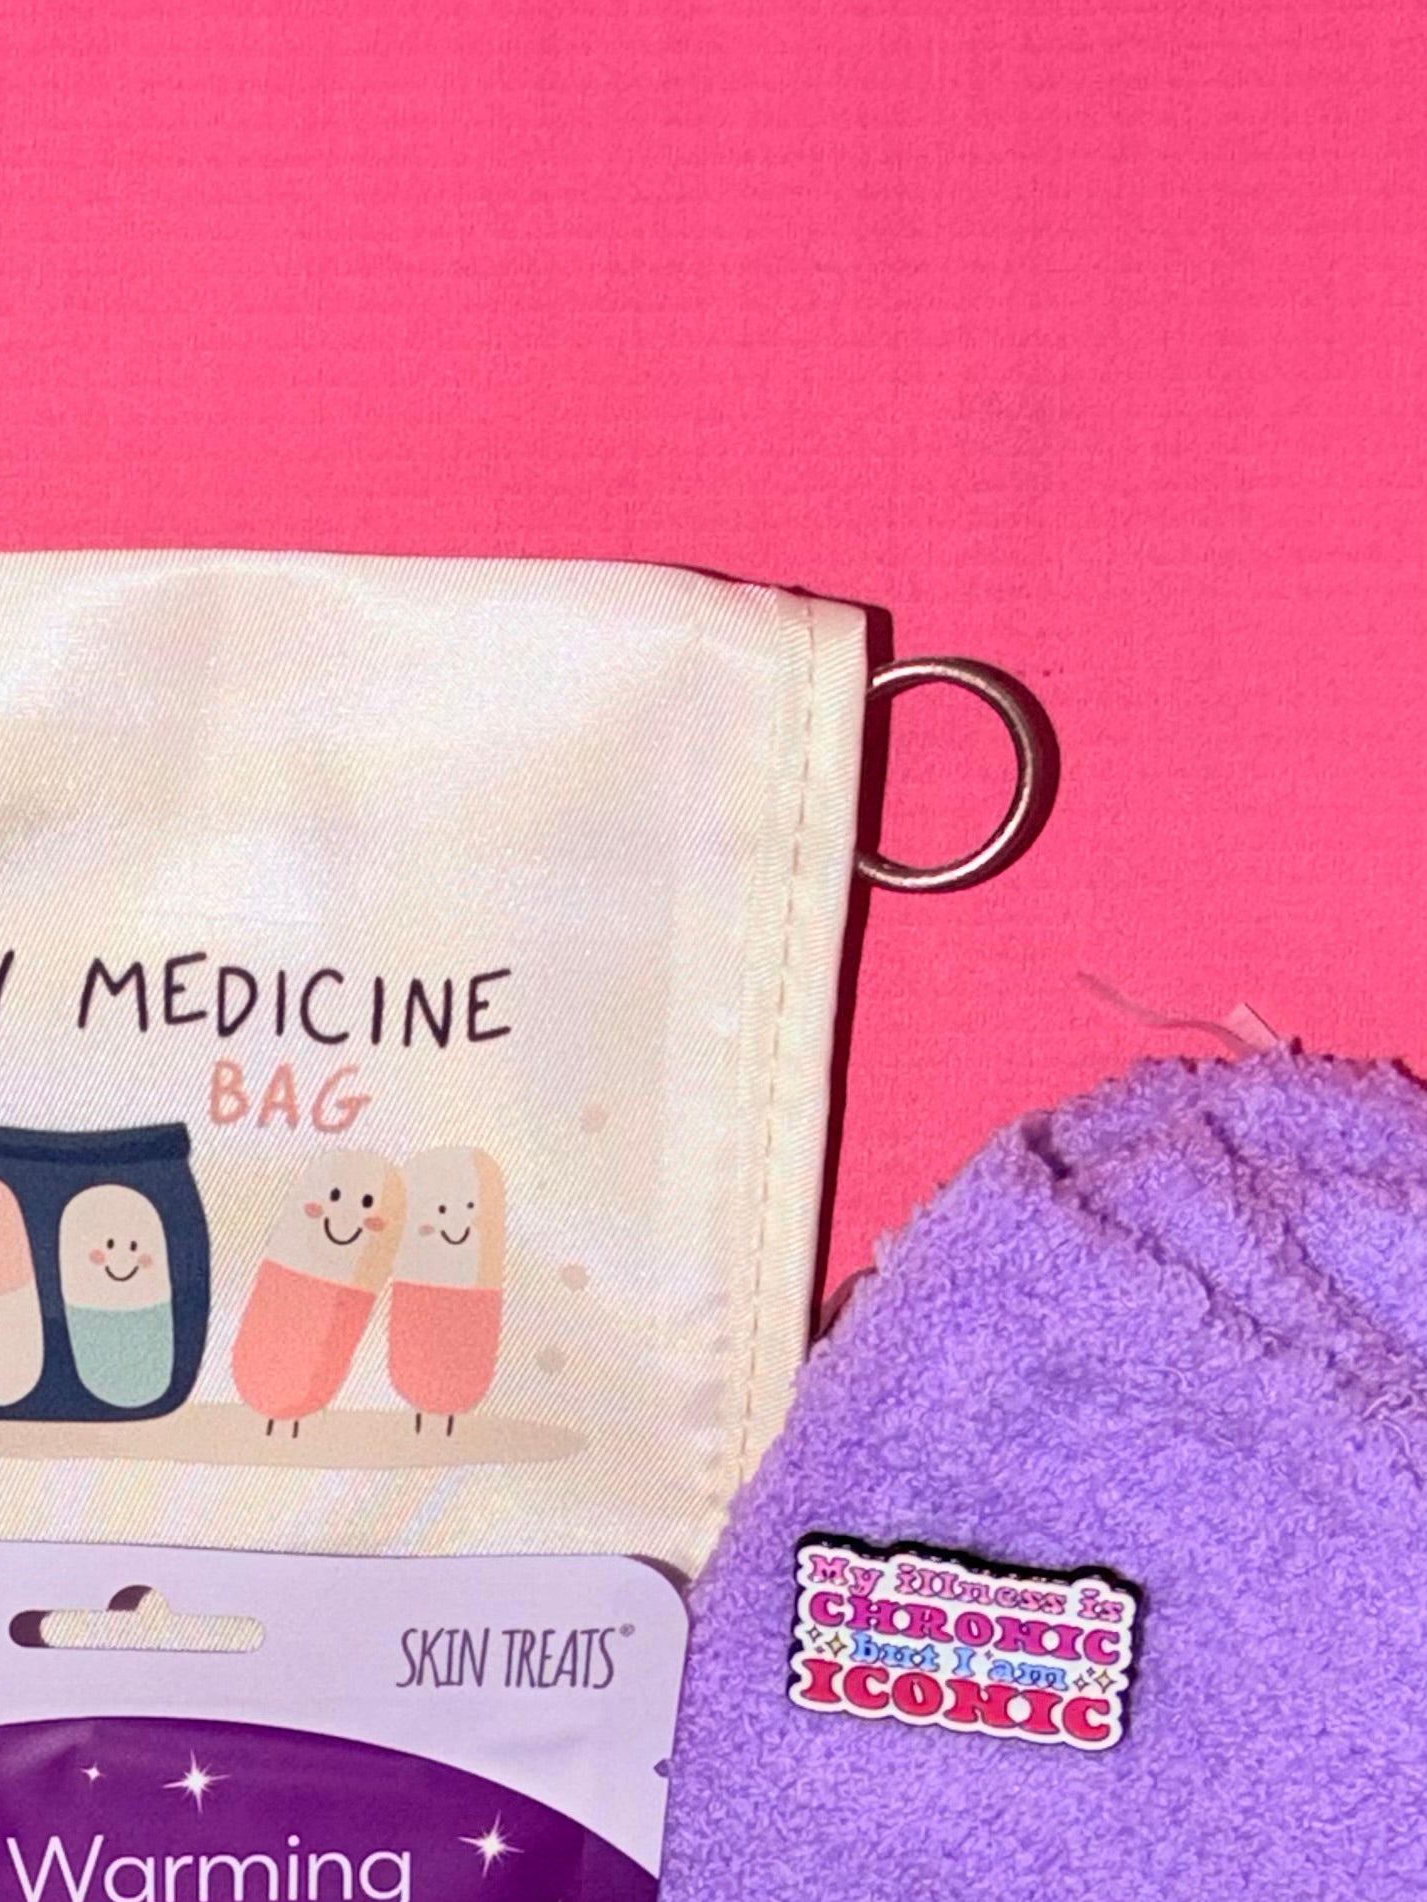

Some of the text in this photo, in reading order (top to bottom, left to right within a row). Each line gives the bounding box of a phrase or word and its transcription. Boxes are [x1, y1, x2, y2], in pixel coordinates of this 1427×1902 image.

[77, 951, 513, 1049] MEDICINE
[207, 1059, 374, 1134] BAG
[808, 1554, 1125, 1624] My illness is
[396, 1627, 490, 1688] SKIN
[808, 1591, 1122, 1666] CHRONIC
[850, 1631, 1070, 1692] but I am
[800, 1658, 1112, 1742] ICONIC
